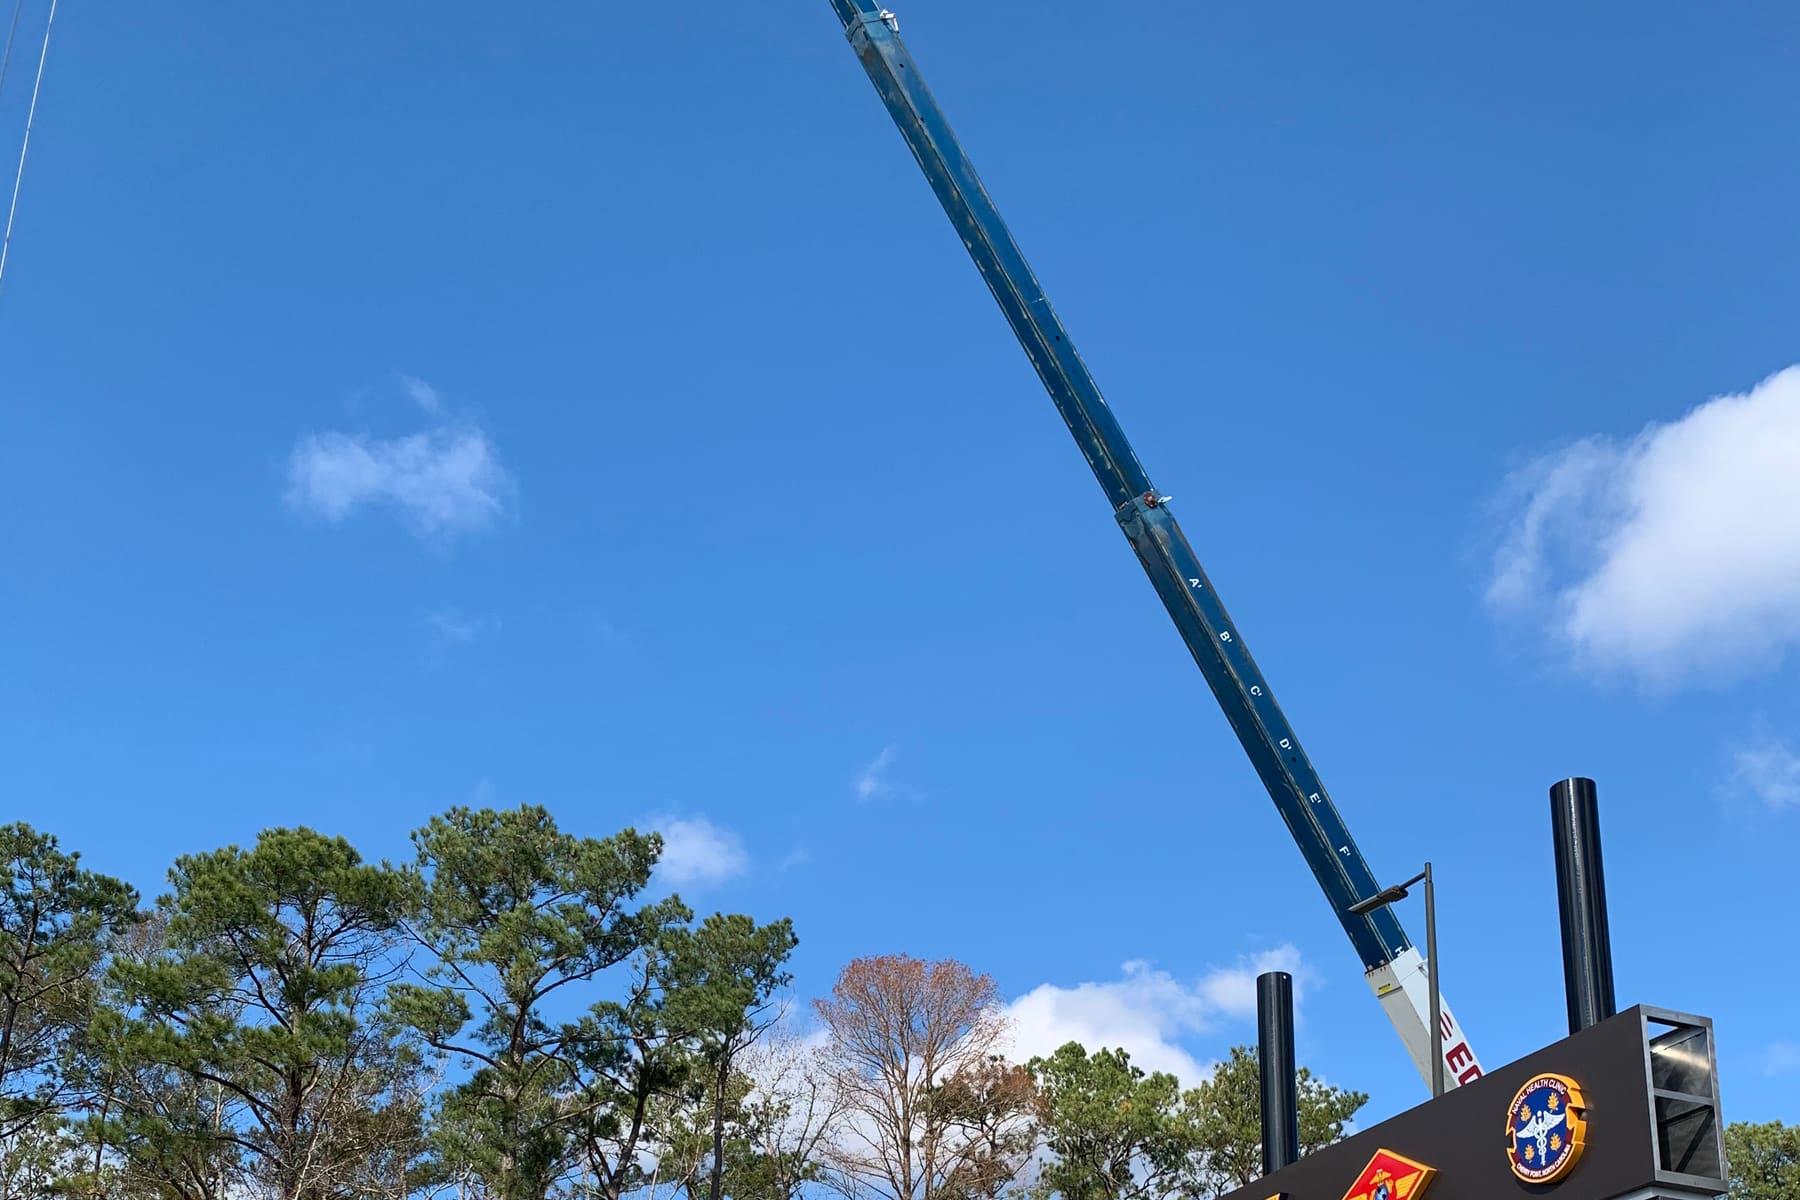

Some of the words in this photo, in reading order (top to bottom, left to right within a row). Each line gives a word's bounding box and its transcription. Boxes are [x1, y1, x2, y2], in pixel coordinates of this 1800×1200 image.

[1512, 1093, 1527, 1114] NAVAL
[1526, 1080, 1549, 1095] HEALTH
[1549, 1080, 1567, 1095] CLINIC
